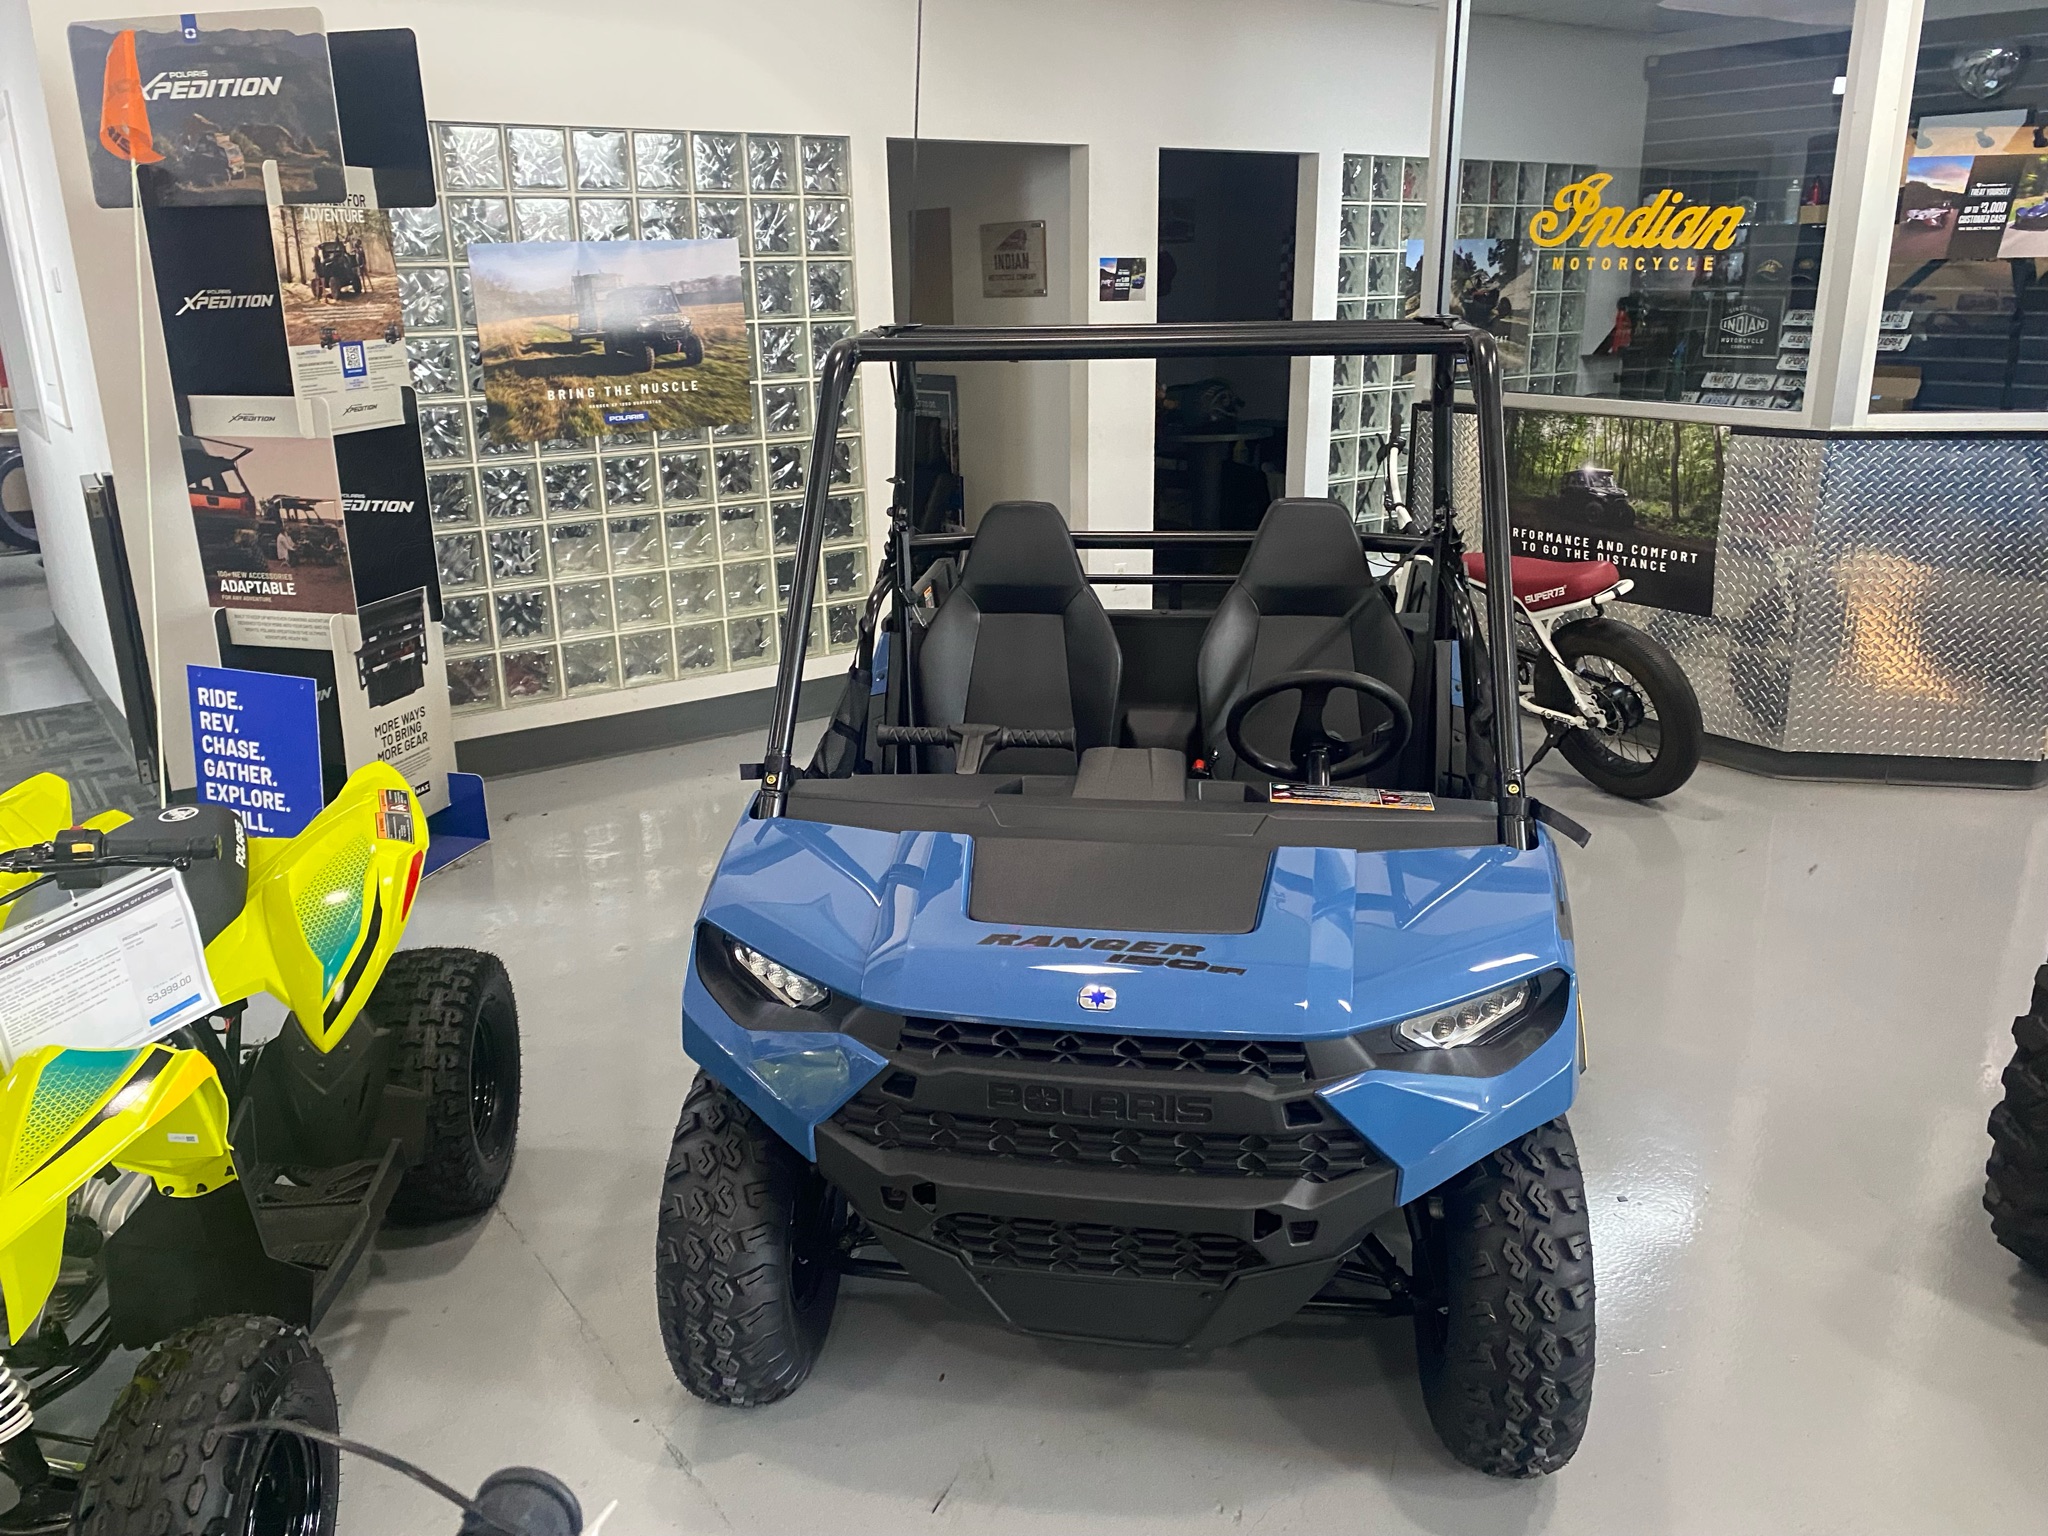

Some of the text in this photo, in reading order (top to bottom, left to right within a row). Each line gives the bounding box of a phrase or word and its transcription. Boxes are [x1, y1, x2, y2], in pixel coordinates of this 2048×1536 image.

[169, 70, 209, 79] POLARIS
[347, 193, 366, 207] FOR
[1529, 172, 1746, 251] Indian
[1980, 201, 2008, 214] $3,000
[303, 207, 366, 223] ADVENTURE
[1958, 214, 2007, 224] CUSTOMER CASH
[994, 252, 1029, 270] INDIAN
[1552, 256, 1714, 271] MOTORCYCLE
[175, 290, 275, 316] XPEDITION
[1723, 315, 1765, 334] INDIAN
[547, 380, 699, 401] BRING THE MUSCLE
[228, 413, 276, 423] XPEDITION
[342, 404, 378, 416] XPEDITION
[608, 413, 645, 421] POLARIS
[1521, 541, 1667, 573] TO GO THE DISTANCE
[1596, 539, 1624, 553] AND
[1631, 544, 1699, 564] COMFORT
[232, 571, 247, 579] NEW
[249, 572, 293, 580] ACCESSORIES
[221, 579, 297, 596] ADAPTABLE
[197, 687, 243, 711] RIDE.
[199, 711, 239, 734] REV.
[374, 706, 426, 738] MORE WAYS
[380, 721, 422, 748] TO BRING
[201, 735, 266, 761] CHASE.
[377, 731, 429, 762] MORE GEAR
[203, 758, 278, 787] GATHER.
[205, 781, 291, 813] EXPLORE.
[234, 818, 246, 869] POLARIS
[58, 929, 71, 938] THE
[72, 918, 95, 931] WORLD
[96, 907, 121, 921] LEADER
[130, 896, 141, 905] OFF
[976, 933, 1207, 958] RANGER
[1103, 953, 1211, 971] 150
[146, 974, 192, 1005] $3,999.00
[987, 1082, 1213, 1125] POLARIS
